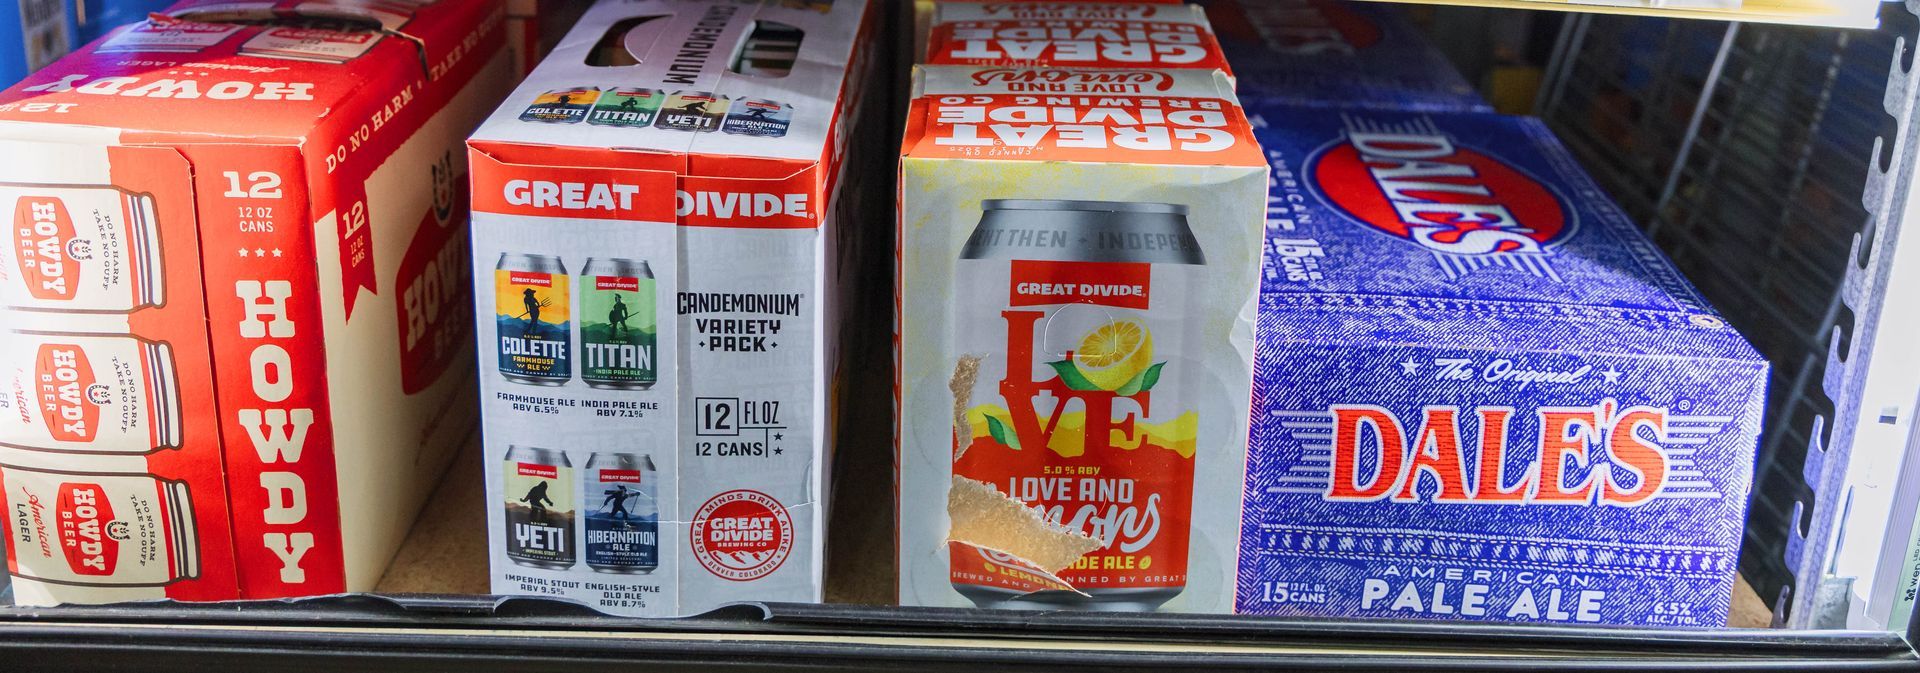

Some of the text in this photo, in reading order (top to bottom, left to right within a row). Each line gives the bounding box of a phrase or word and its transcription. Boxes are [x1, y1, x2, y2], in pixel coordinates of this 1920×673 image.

[952, 27, 1200, 43] DIVIDE
[951, 40, 1206, 62] GREAT
[22, 74, 315, 101] HOWDY
[1008, 82, 1141, 93] LOVE AND
[19, 103, 80, 113] 12
[525, 107, 585, 117] COLETTE
[939, 96, 1221, 109] BREWING CO
[594, 110, 651, 123] TITAN
[666, 114, 712, 128] YETI
[726, 119, 786, 131] HIBERNATION
[937, 106, 1229, 127] DIVIDE
[325, 144, 347, 175] DO
[349, 124, 370, 152] NO
[371, 85, 414, 131] HARM
[935, 124, 1236, 152] GREAT
[223, 171, 283, 199] 12
[1350, 133, 1547, 255] DALE'S
[504, 180, 809, 218] GREAT DIVIDE
[238, 207, 273, 218] 12 OZ
[342, 201, 365, 240] 12
[239, 220, 274, 233] CANS
[20, 228, 36, 268] BEER
[32, 202, 67, 295] HOWDY
[1007, 229, 1067, 248] THEN
[93, 209, 112, 291] TAKE NO GUFF
[104, 216, 120, 285] DO NO HARM
[351, 251, 365, 268] CANS
[1281, 257, 1310, 281] CANS
[1017, 282, 1143, 297] GREAT DIVIDE
[677, 292, 799, 316] CANDEMONIUM
[696, 319, 781, 334] VARIETY
[502, 336, 566, 360] COLETTE
[709, 336, 767, 352] PACK
[513, 356, 555, 365] FARMHOUSE
[586, 343, 651, 370] TITAN
[1434, 358, 1594, 390] The Original
[41, 374, 57, 411] BEER
[52, 350, 87, 437] HOWDY
[112, 356, 129, 434] TAKE NO GUFF
[122, 362, 138, 428] DO NO HARM
[497, 392, 575, 407] FARMHOUSE ALE
[513, 403, 559, 415] ABV 6.5%
[582, 400, 658, 410] INDIA PALE ALE
[597, 409, 643, 418] ABV 7.1%
[705, 401, 780, 430] 12 FL OZ
[235, 280, 315, 584] HOWDY
[695, 442, 763, 456] 12 CANS
[1324, 398, 1671, 507] DALE'S
[1044, 466, 1062, 474] 5.0
[1078, 466, 1100, 475] ABV
[1010, 477, 1134, 503] LOVE AND
[16, 503, 31, 543] LAGER
[22, 486, 52, 558] American
[141, 499, 149, 513] DO
[146, 515, 154, 530] NO
[695, 515, 706, 554] GREAT
[704, 493, 744, 514] MINDS
[748, 493, 783, 517] DRINK
[710, 517, 774, 529] GREAT
[61, 511, 77, 547] BEER
[72, 489, 106, 571] HOWDY
[130, 494, 148, 567] TAKE NO GUFF
[515, 523, 564, 552] YETI
[587, 530, 656, 546] HIBERNATION
[710, 529, 774, 542] DIVIDE
[707, 561, 777, 578] DENVER COLORADO
[1104, 556, 1135, 569] ALE
[505, 574, 580, 589] IMPERIAL STOUT
[1001, 579, 1031, 589] AND
[1145, 575, 1179, 583] GREAT
[1383, 565, 1590, 586] AMERICAN
[521, 584, 565, 595] ABV 9.5%
[585, 583, 660, 593] ENGLISH-STYLE
[1261, 581, 1290, 603] 15
[1290, 583, 1299, 591] 12
[1289, 592, 1326, 603] CANS
[600, 599, 646, 608] ABV 8.7%
[1361, 578, 1606, 622] PALE ALE
[1654, 601, 1692, 615] 6.5%
[1646, 615, 1701, 625] ALC./VOL.
